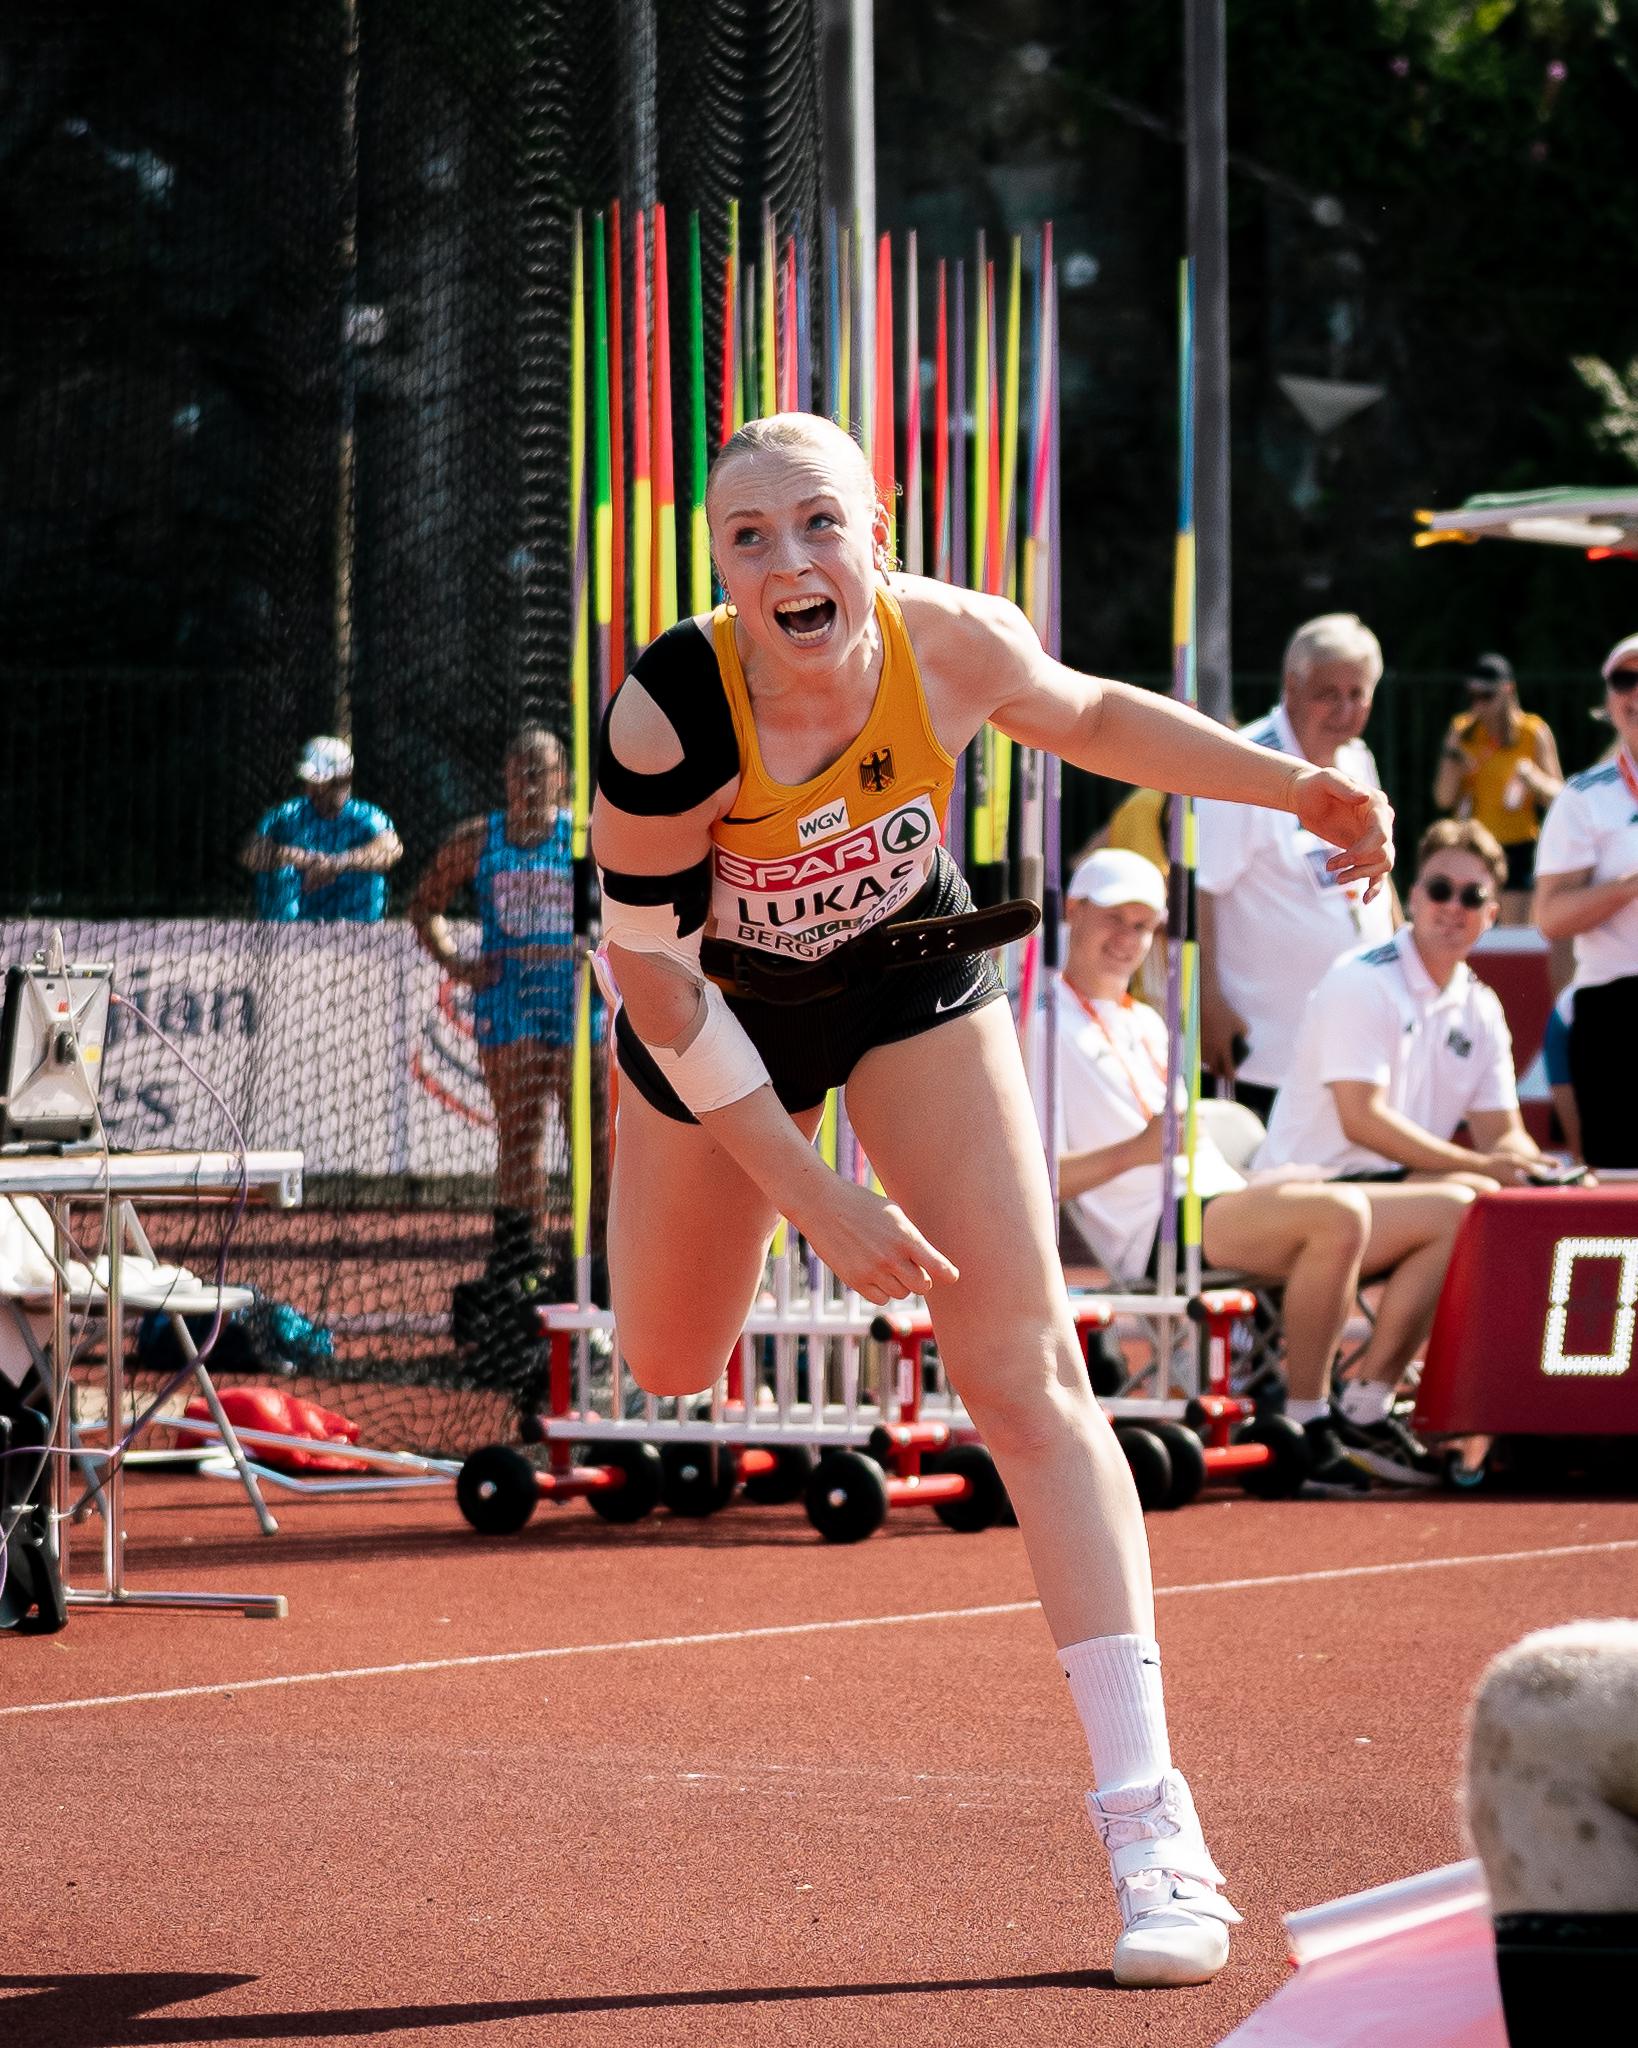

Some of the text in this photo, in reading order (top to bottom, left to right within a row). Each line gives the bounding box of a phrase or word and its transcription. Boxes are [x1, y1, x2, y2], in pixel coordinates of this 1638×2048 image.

[799, 806, 845, 838] WGV
[719, 836, 875, 889] SPAR
[859, 881, 909, 934] 2025
[1541, 1236, 1638, 1376] 0
